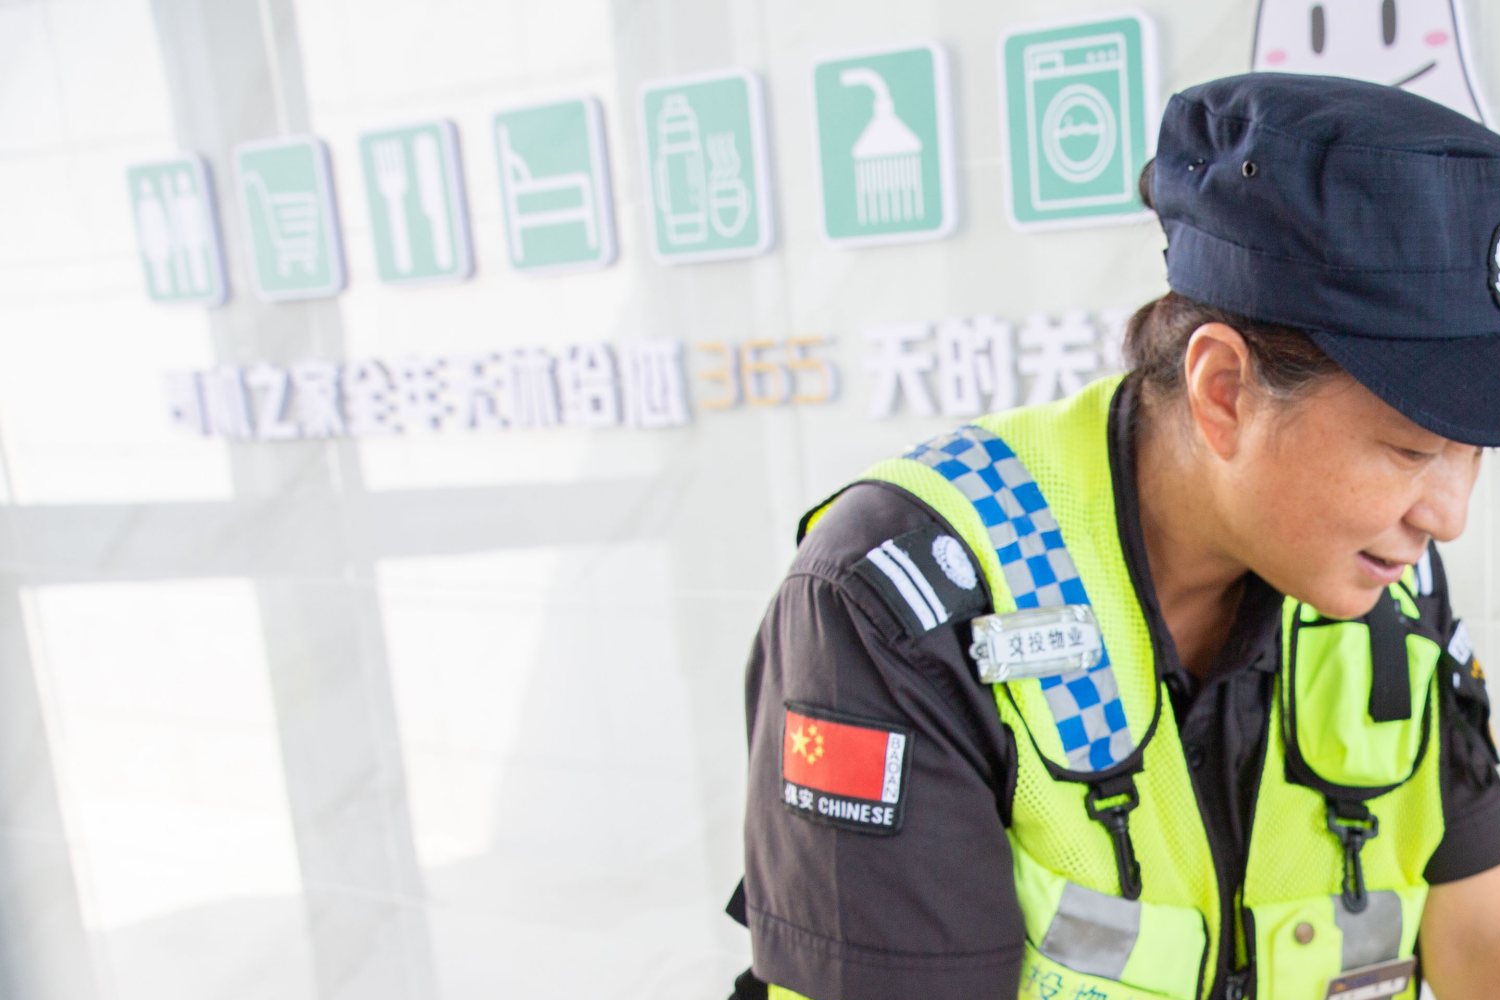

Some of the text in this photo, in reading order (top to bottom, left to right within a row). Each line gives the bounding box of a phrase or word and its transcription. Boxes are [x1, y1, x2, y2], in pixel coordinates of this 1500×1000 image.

[694, 336, 838, 410] 365
[886, 736, 901, 799] BAOAN
[818, 797, 895, 826] CHINESE
